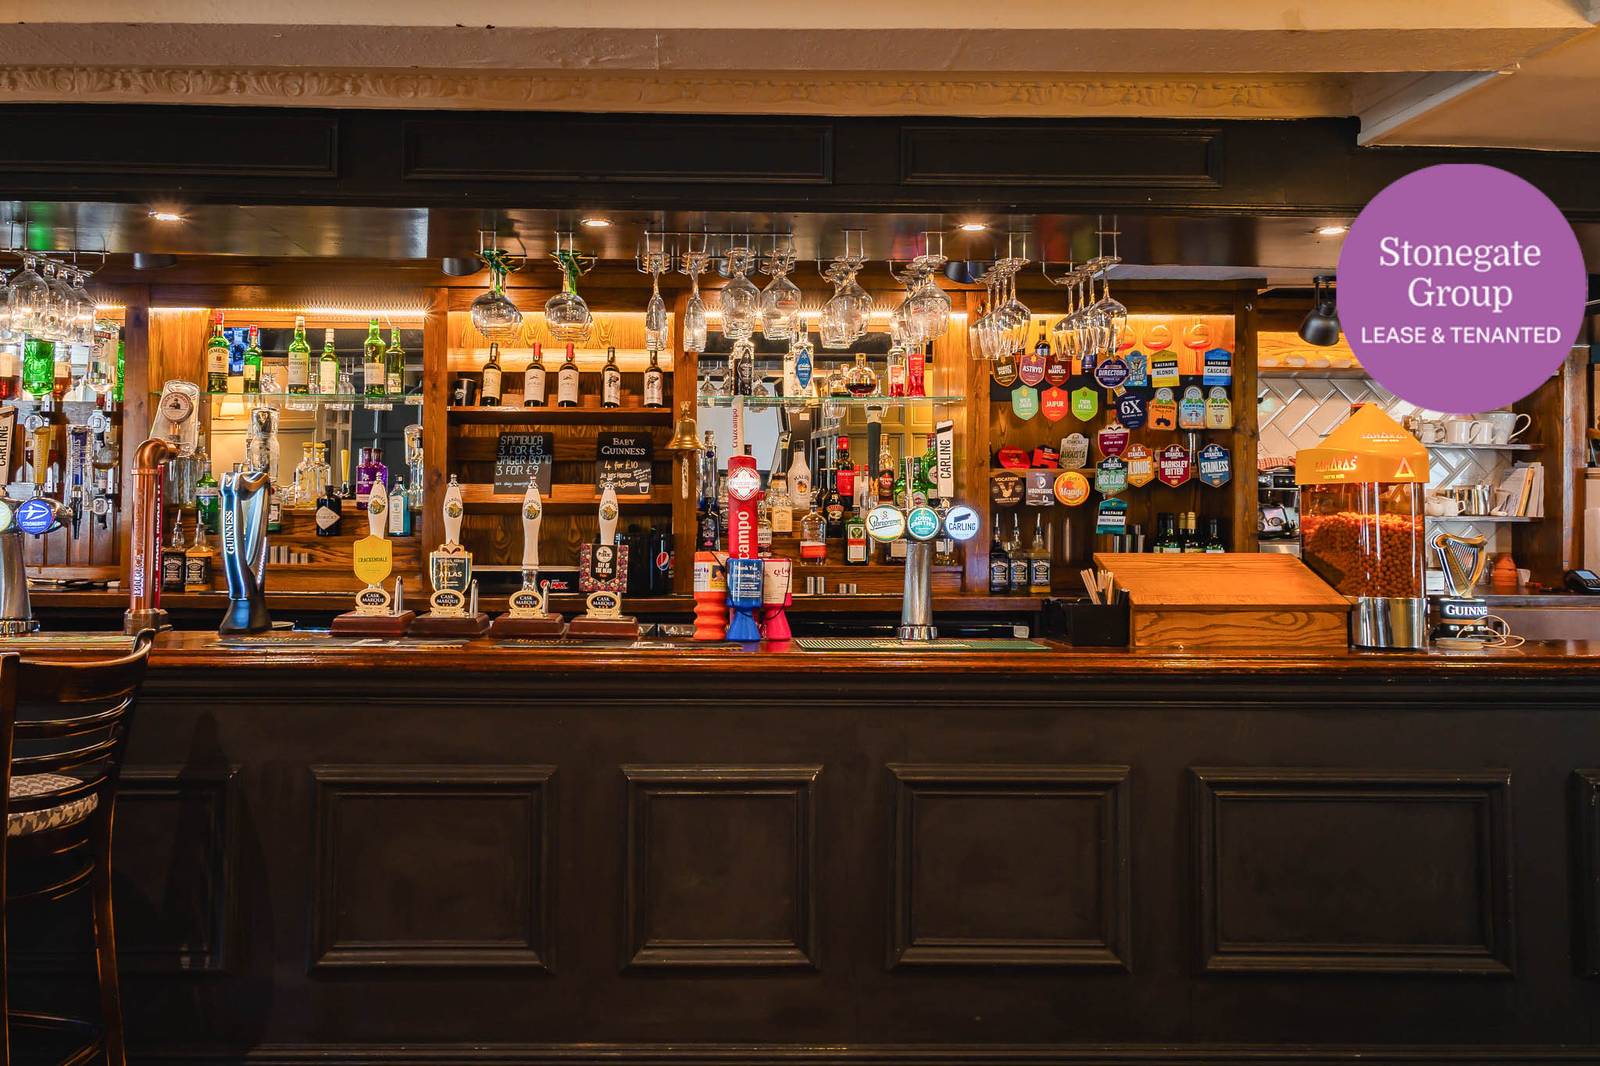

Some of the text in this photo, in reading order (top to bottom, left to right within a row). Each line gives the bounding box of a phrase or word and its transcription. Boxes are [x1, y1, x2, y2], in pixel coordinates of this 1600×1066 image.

[1121, 400, 1142, 415] 6X
[501, 435, 543, 445] SAMBUCA
[602, 446, 646, 455] GUINNESS
[940, 439, 951, 479] CARLING
[496, 465, 539, 476] 3 FOR £9
[604, 460, 611, 470] 4
[625, 460, 639, 469] £10
[1201, 461, 1228, 473] STAINLESS
[226, 510, 235, 554] GUINNESS
[949, 522, 975, 531] CARLING
